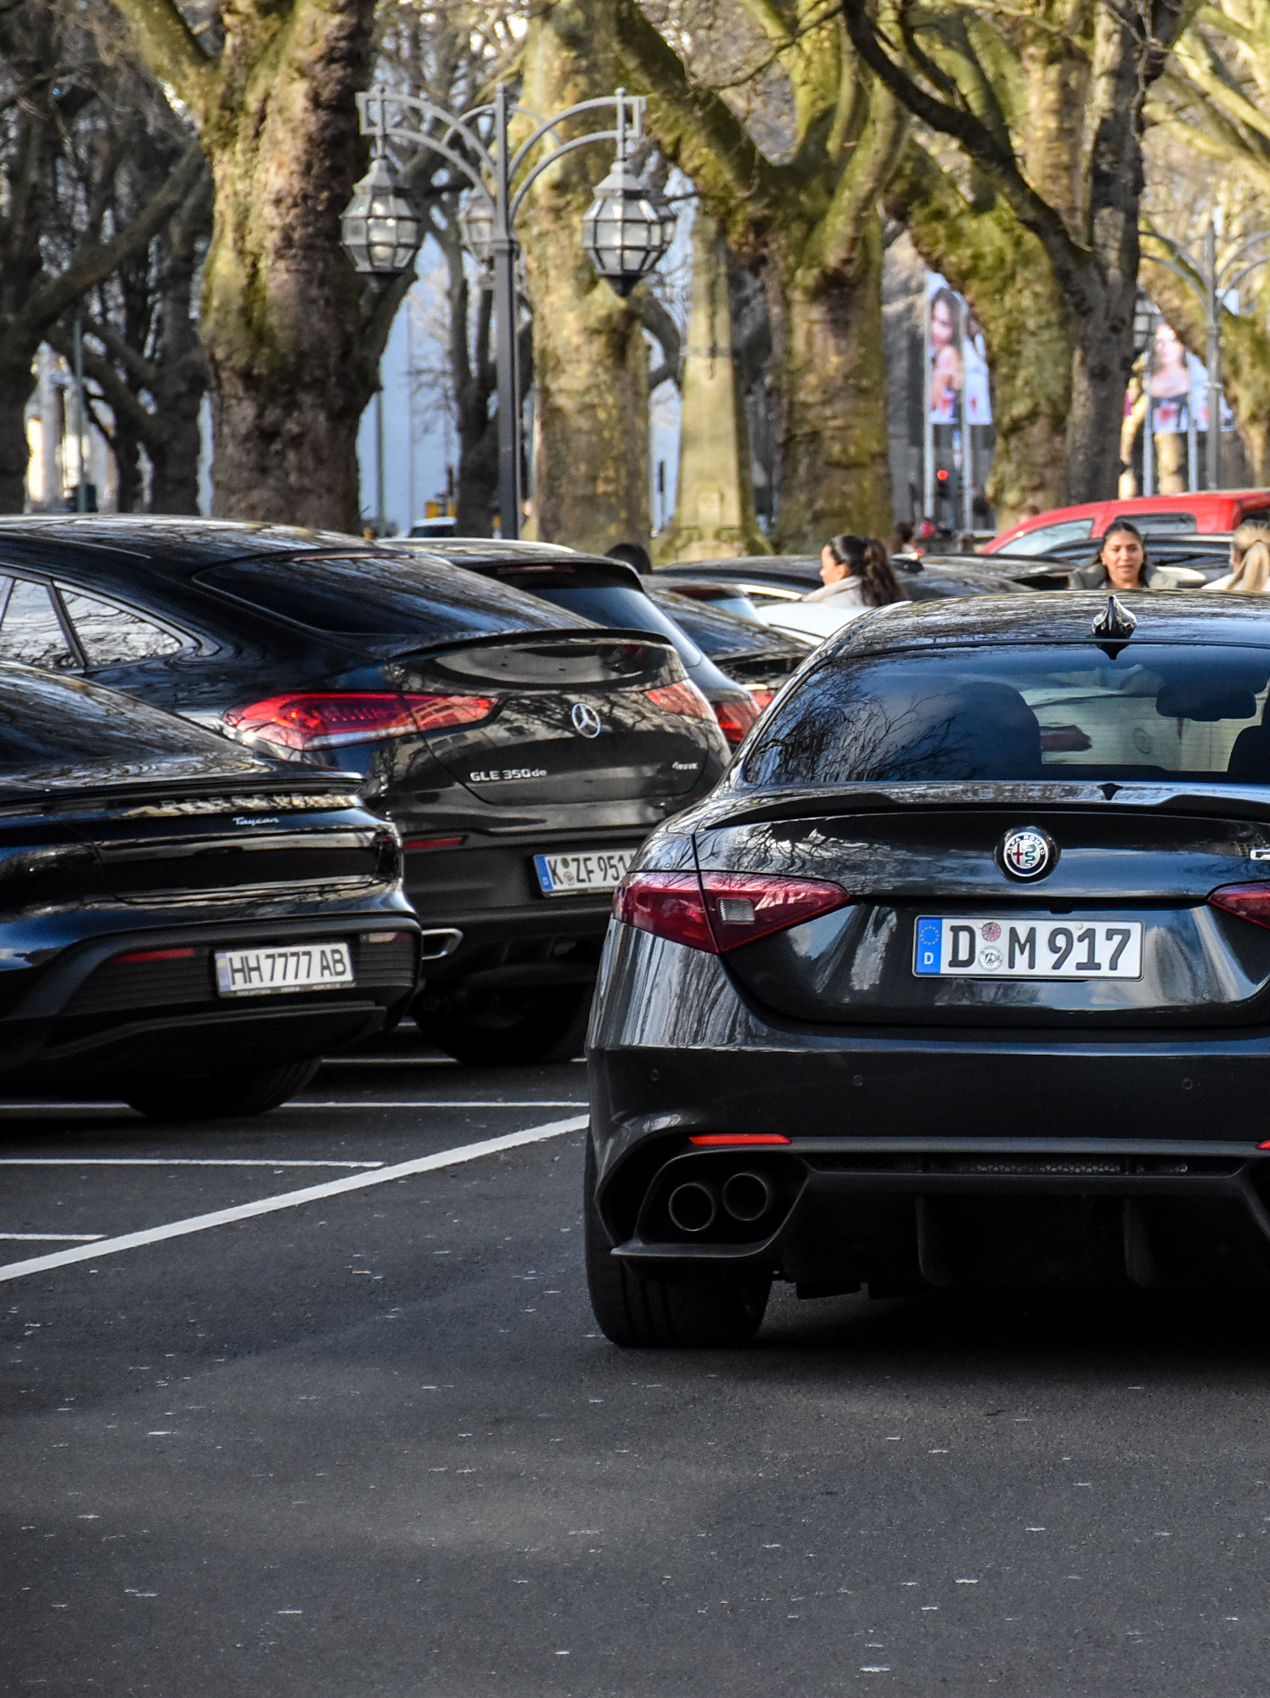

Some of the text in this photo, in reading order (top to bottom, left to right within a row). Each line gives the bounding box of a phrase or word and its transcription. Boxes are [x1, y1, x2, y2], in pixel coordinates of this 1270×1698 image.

[470, 767, 547, 782] GLE 350de
[232, 816, 280, 828] Taycan
[547, 854, 634, 885] K ZF 951
[923, 951, 934, 966] D
[947, 924, 1132, 971] D M 917
[319, 948, 348, 977] AB
